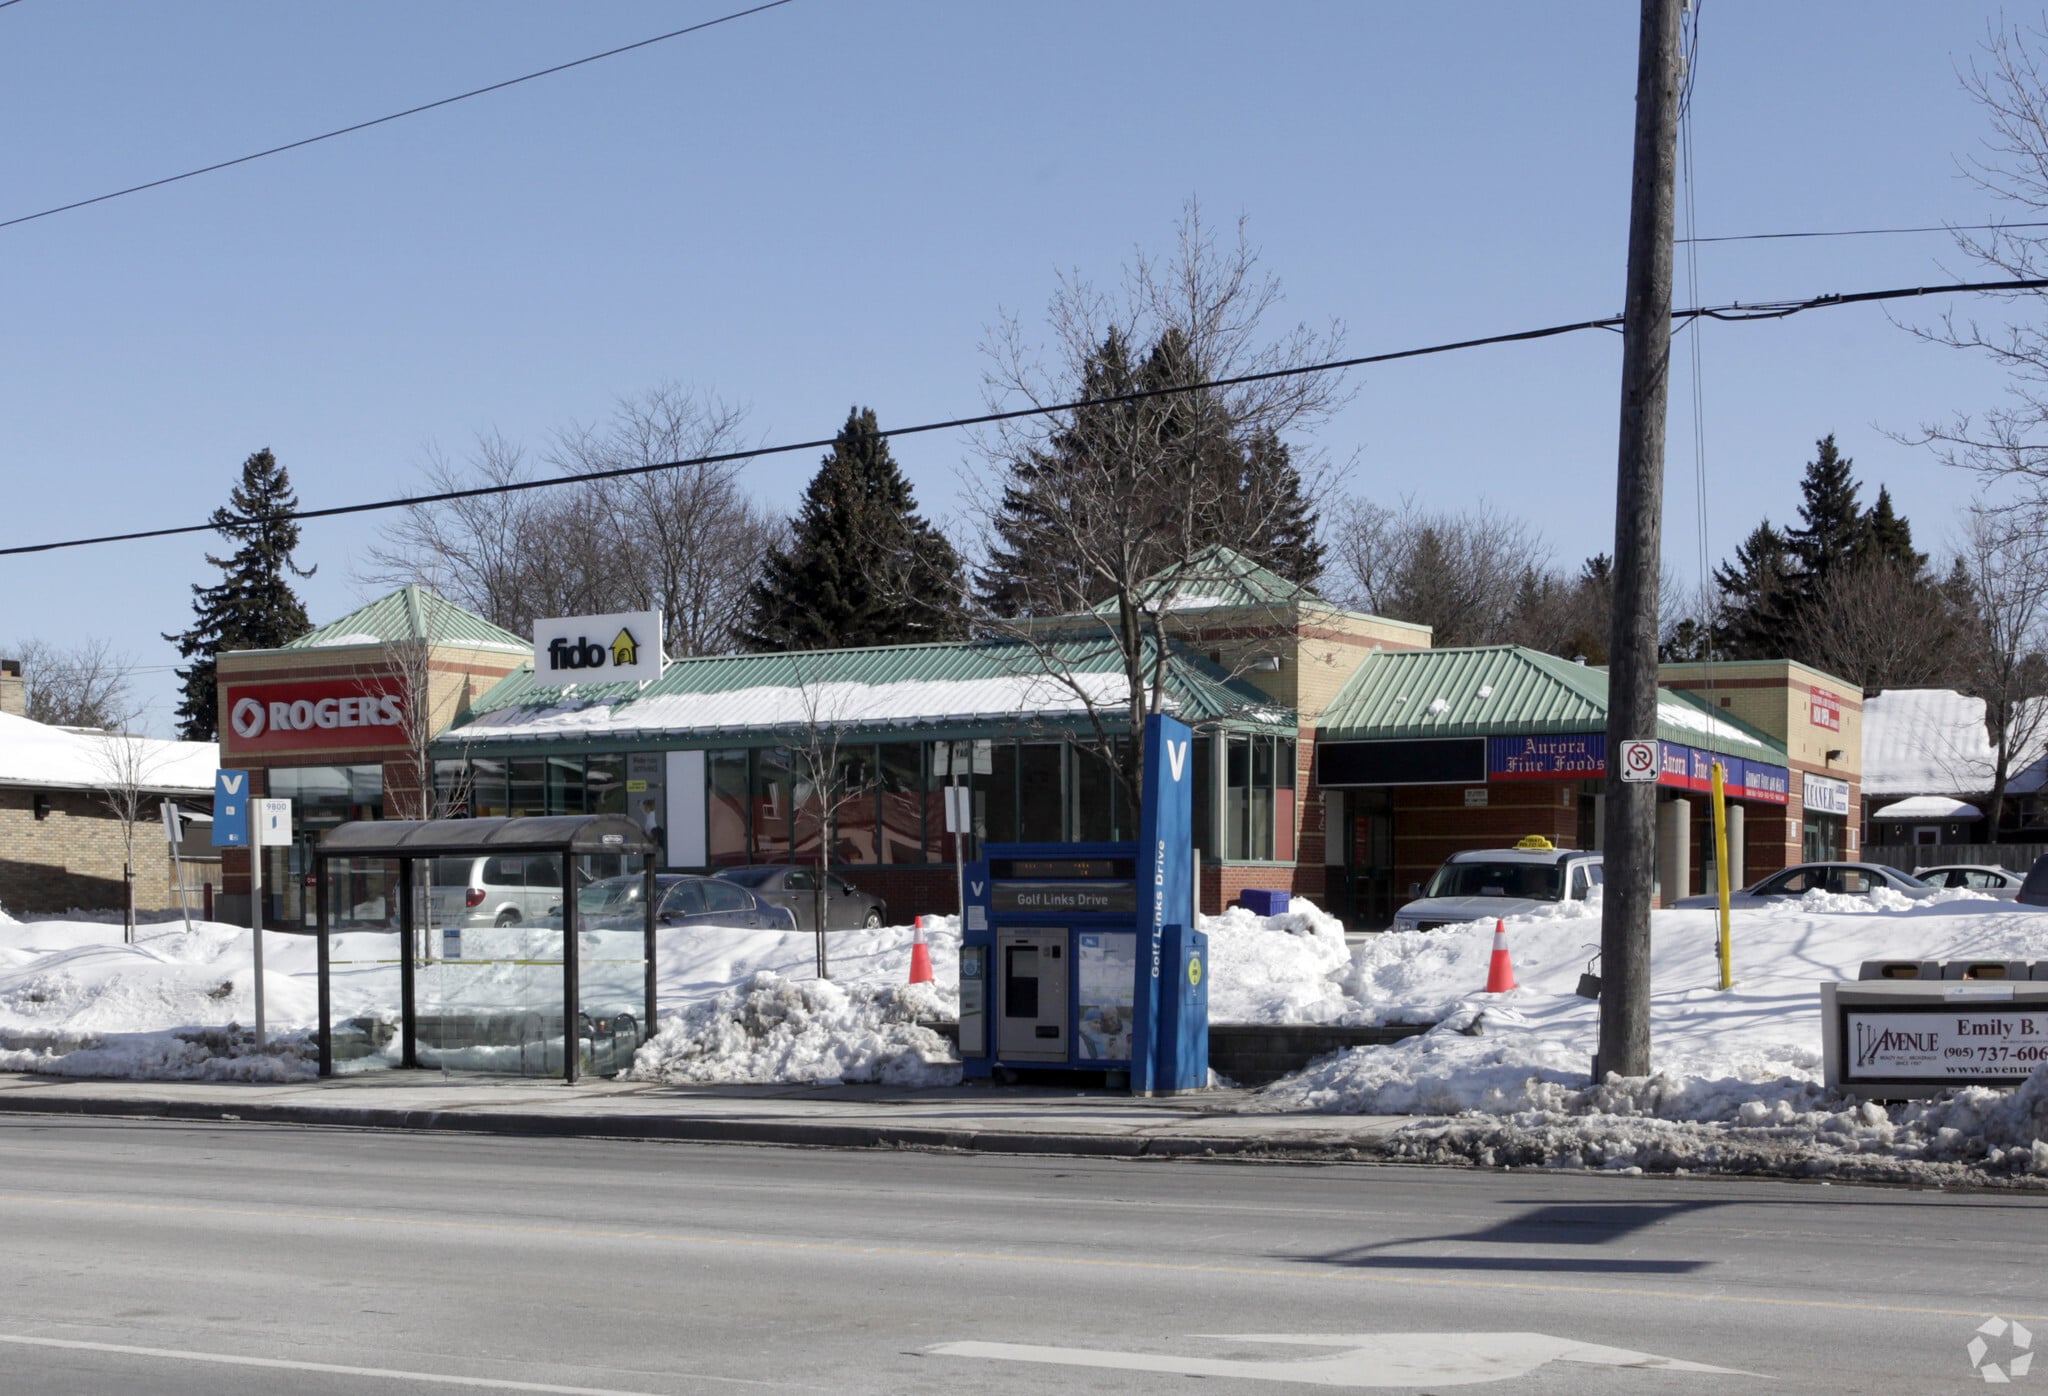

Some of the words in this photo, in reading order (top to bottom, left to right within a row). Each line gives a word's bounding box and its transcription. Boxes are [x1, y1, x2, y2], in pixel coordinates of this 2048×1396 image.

[547, 636, 606, 670] fido
[269, 694, 402, 731] ROGERS
[1524, 738, 1586, 755] Aurora
[1167, 739, 1187, 782] V
[1505, 756, 1544, 773] Fine
[1553, 755, 1605, 771] Foods
[220, 774, 243, 795] V
[266, 802, 287, 811] 9800
[1155, 839, 1165, 886] Drive
[971, 881, 984, 897] V
[1018, 893, 1040, 905] Golf
[1043, 893, 1075, 905] Links
[1078, 893, 1108, 905] Drive
[1153, 890, 1163, 938] Links
[1151, 942, 1161, 978] Golf
[1957, 1019, 2014, 1040] Emily
[2020, 1018, 2040, 1036] B.
[1869, 1027, 1939, 1059] AVENUE
[1944, 1047, 1974, 1060] (905)
